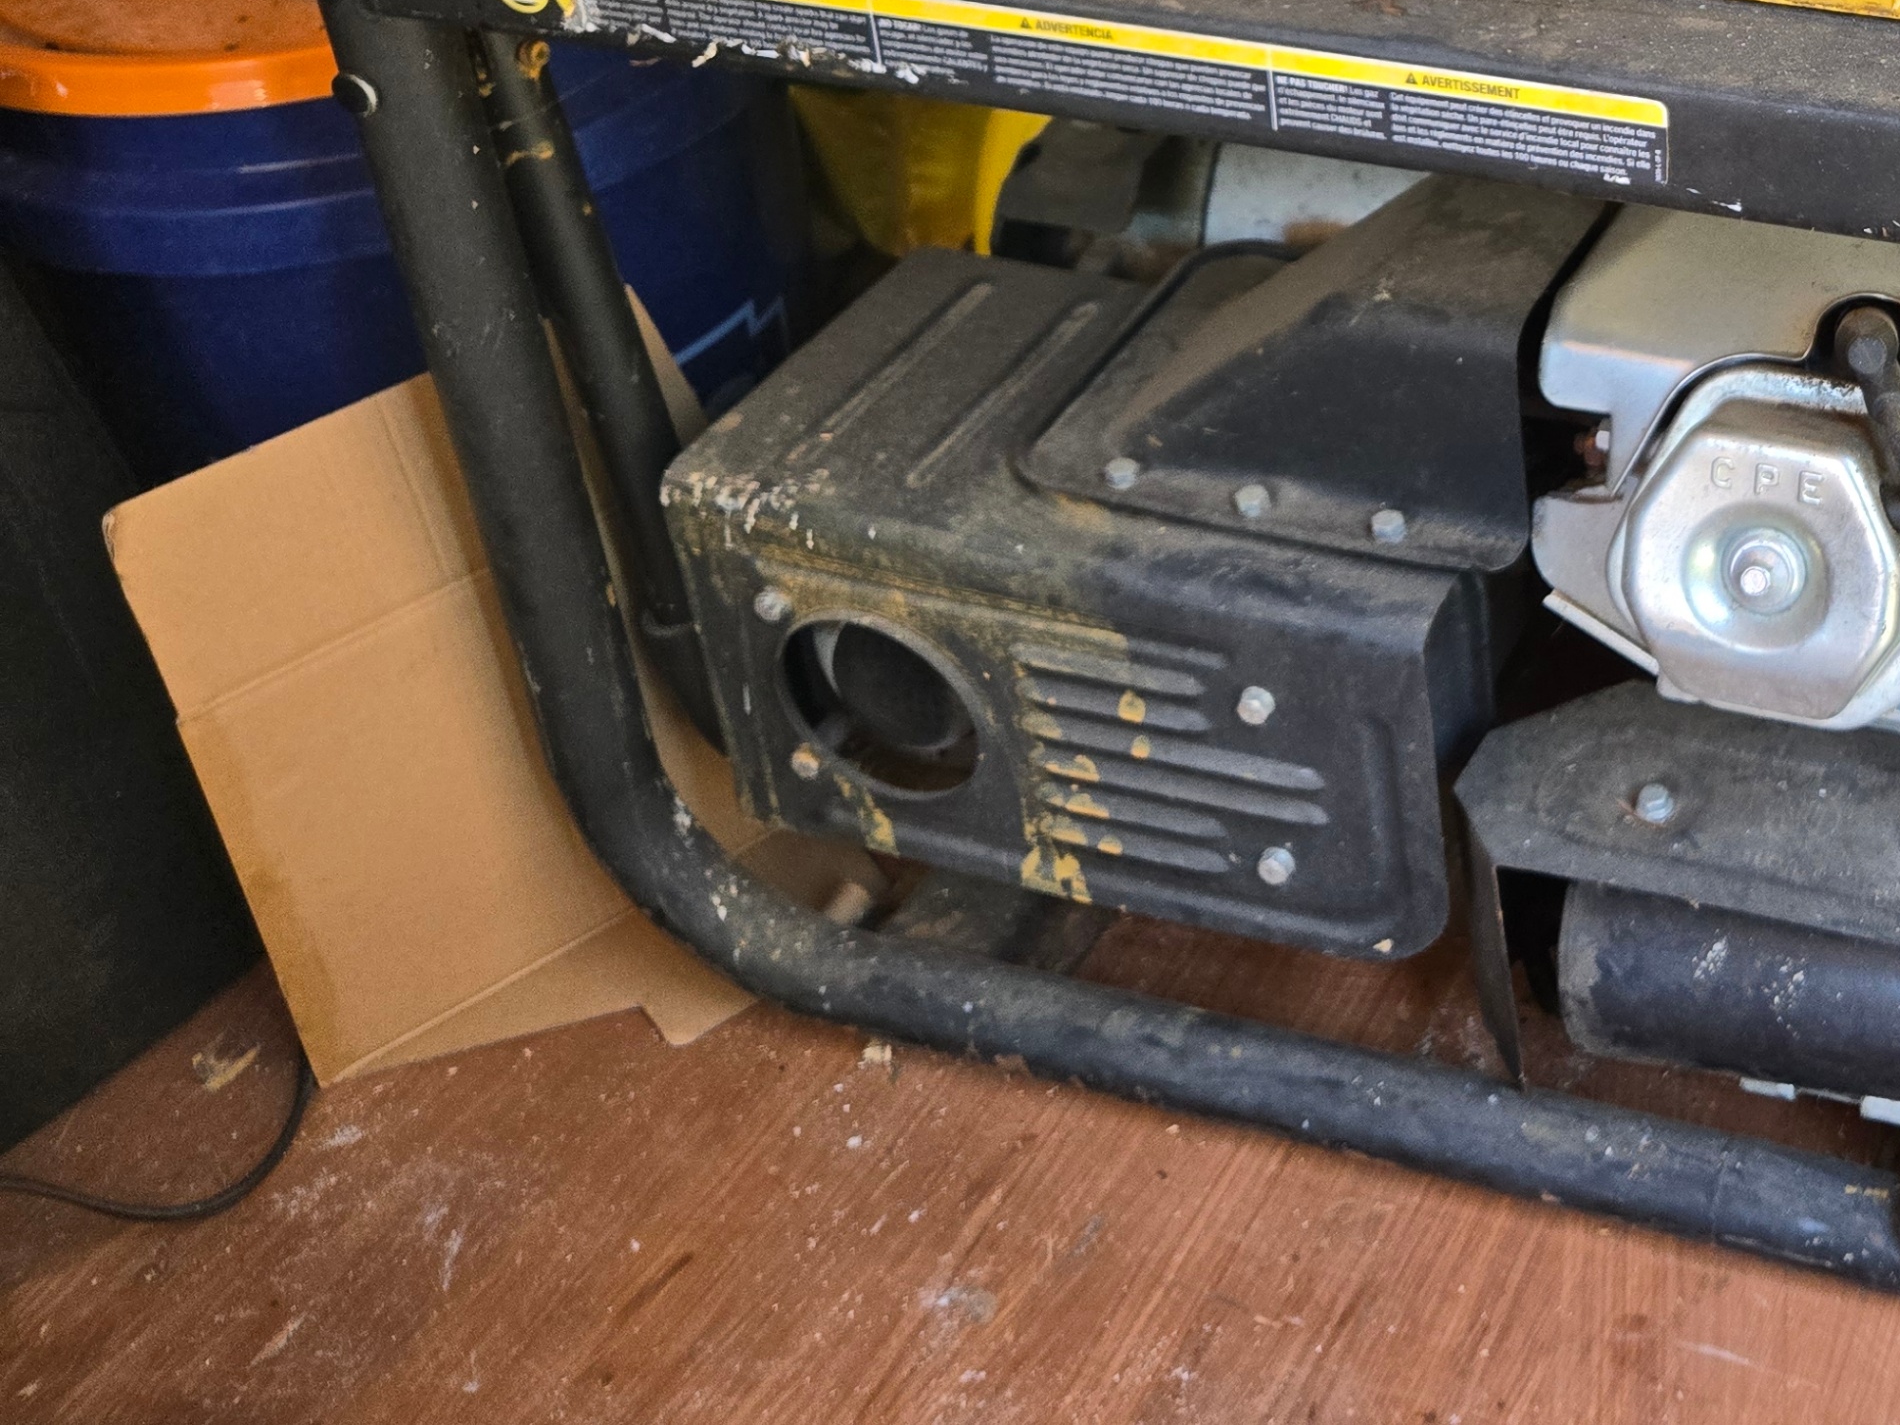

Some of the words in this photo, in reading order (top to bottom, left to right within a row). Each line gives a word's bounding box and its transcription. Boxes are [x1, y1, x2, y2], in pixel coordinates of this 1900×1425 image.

[1036, 20, 1113, 41] ADVERTENCIA
[1422, 75, 1520, 100] AVERTISSEMENT
[1711, 456, 1825, 505] CPE
